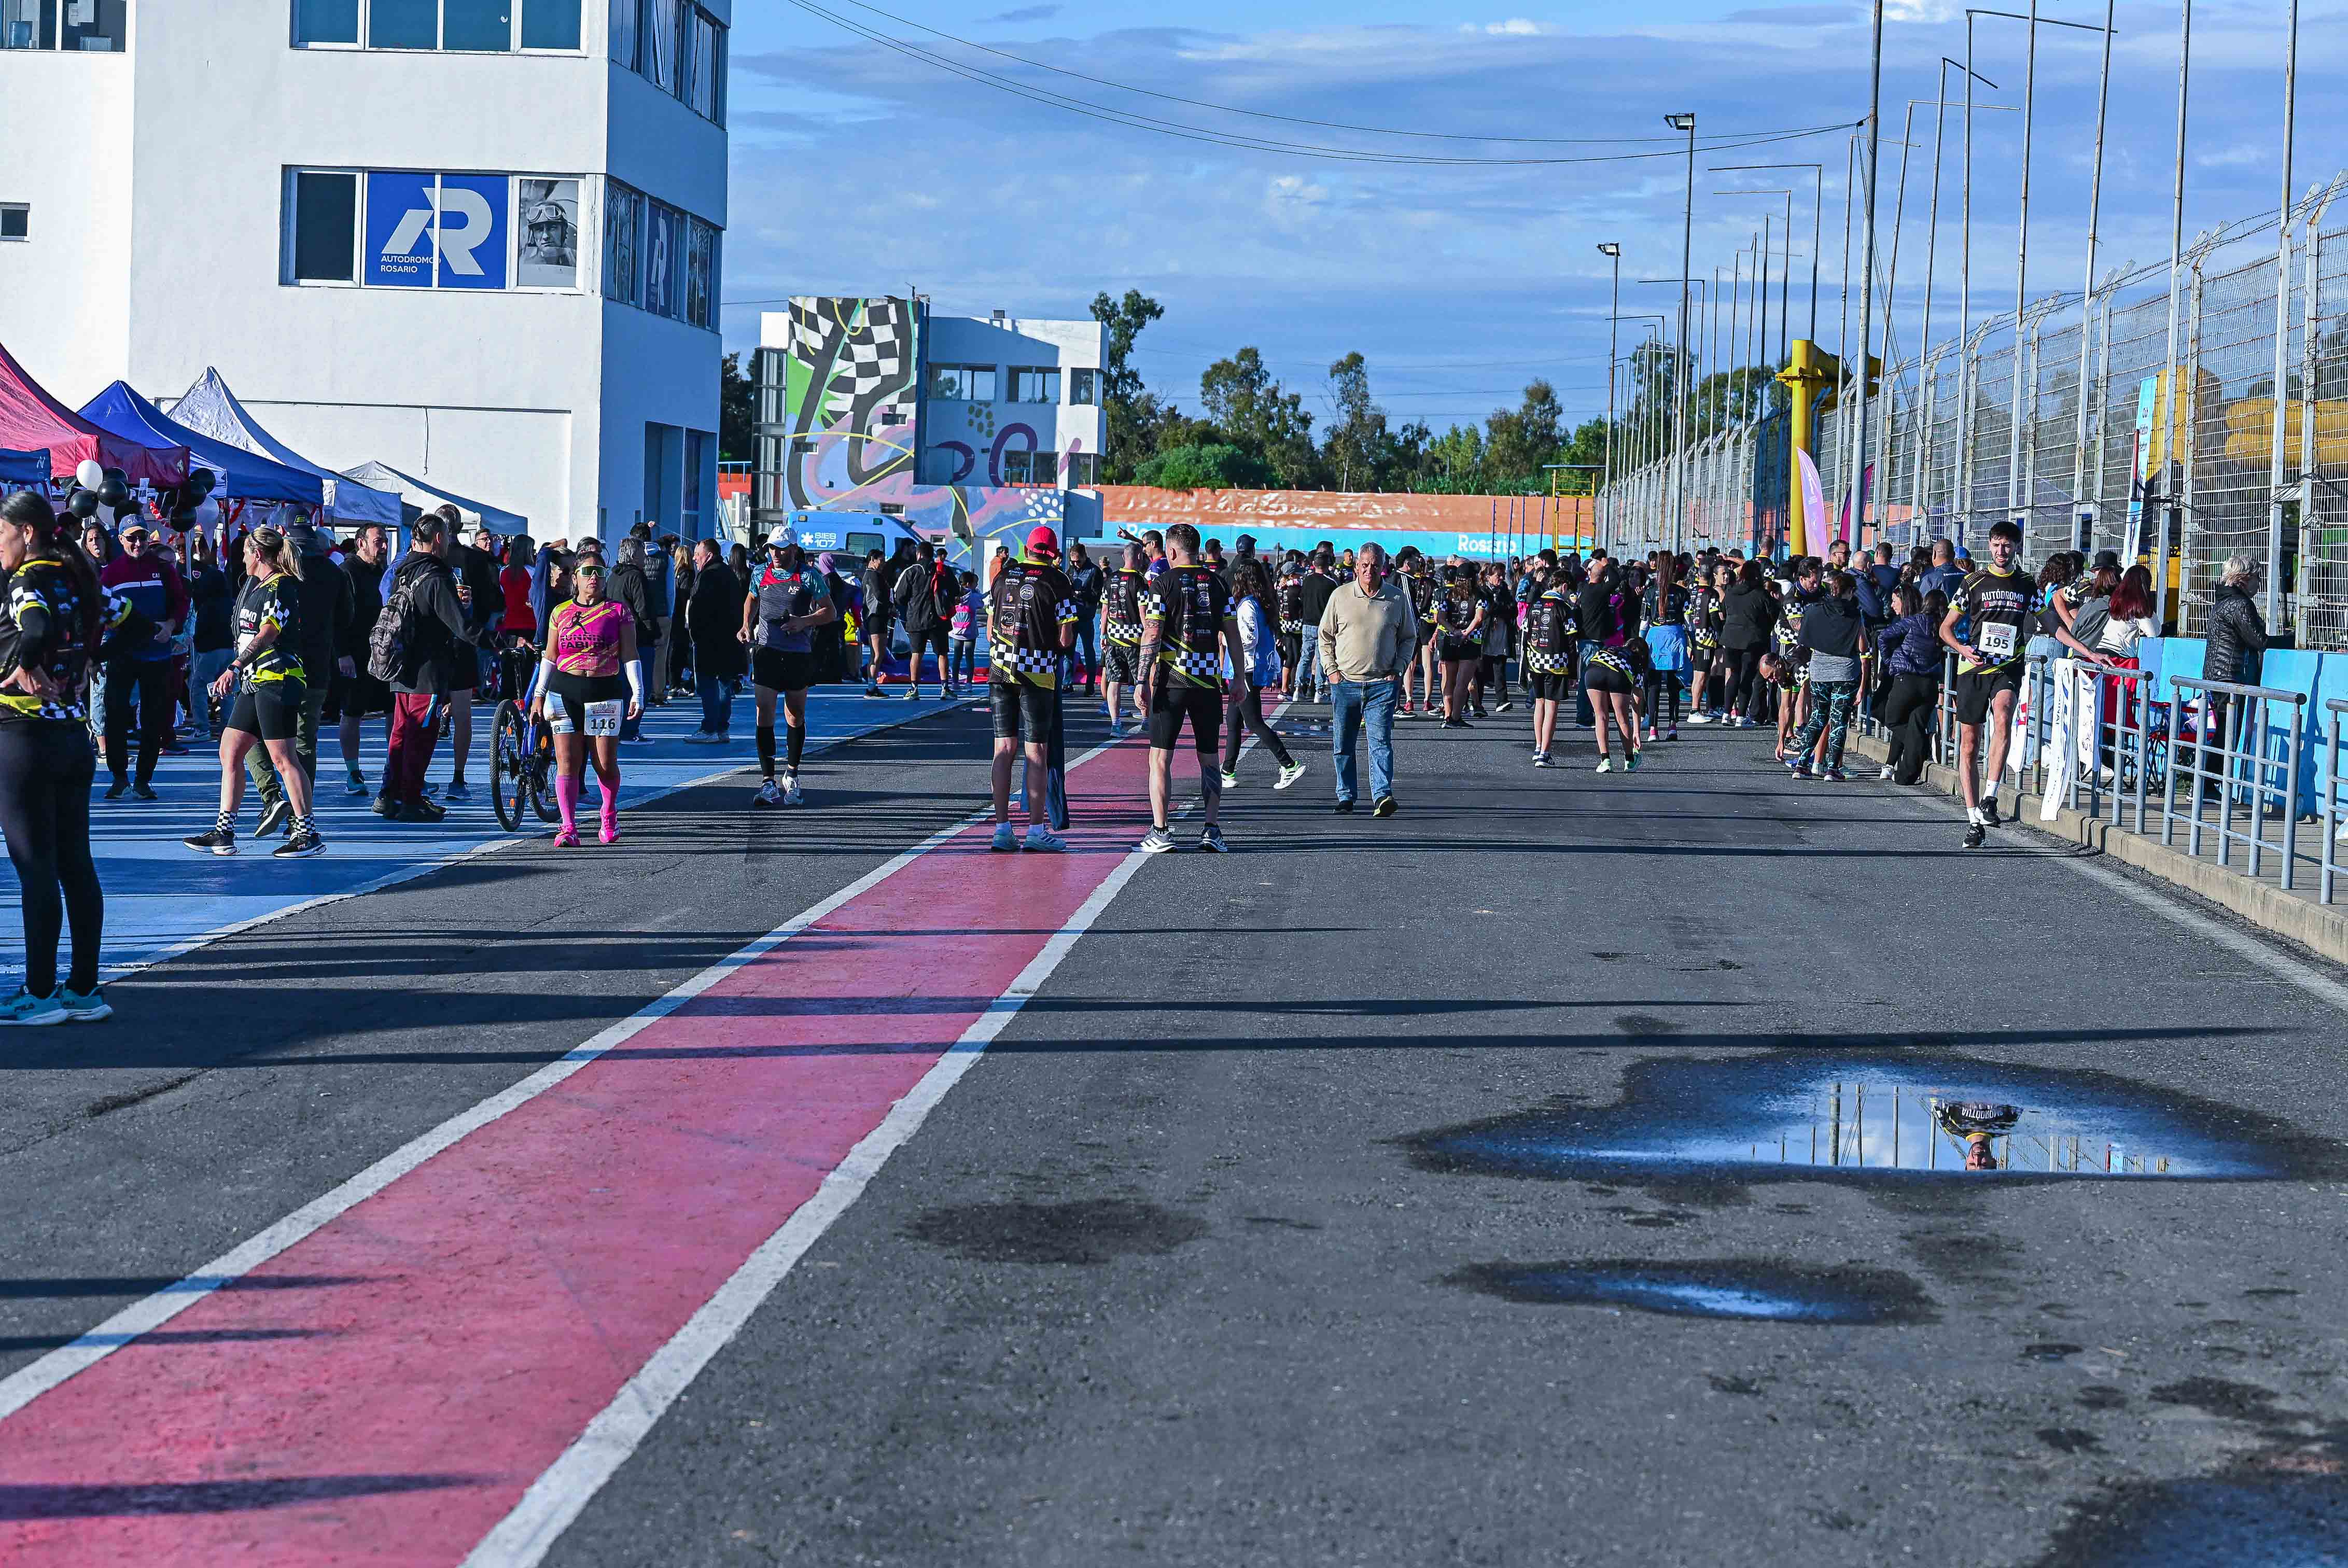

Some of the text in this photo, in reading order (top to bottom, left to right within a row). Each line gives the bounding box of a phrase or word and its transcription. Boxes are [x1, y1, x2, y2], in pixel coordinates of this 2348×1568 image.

[814, 539, 836, 548] 107
[1457, 534, 1517, 553] Rosario
[1981, 589, 2023, 603] AUTÓDROMO
[560, 634, 607, 642] RUNNI
[1985, 636, 2008, 649] 195
[591, 718, 616, 730] 116
